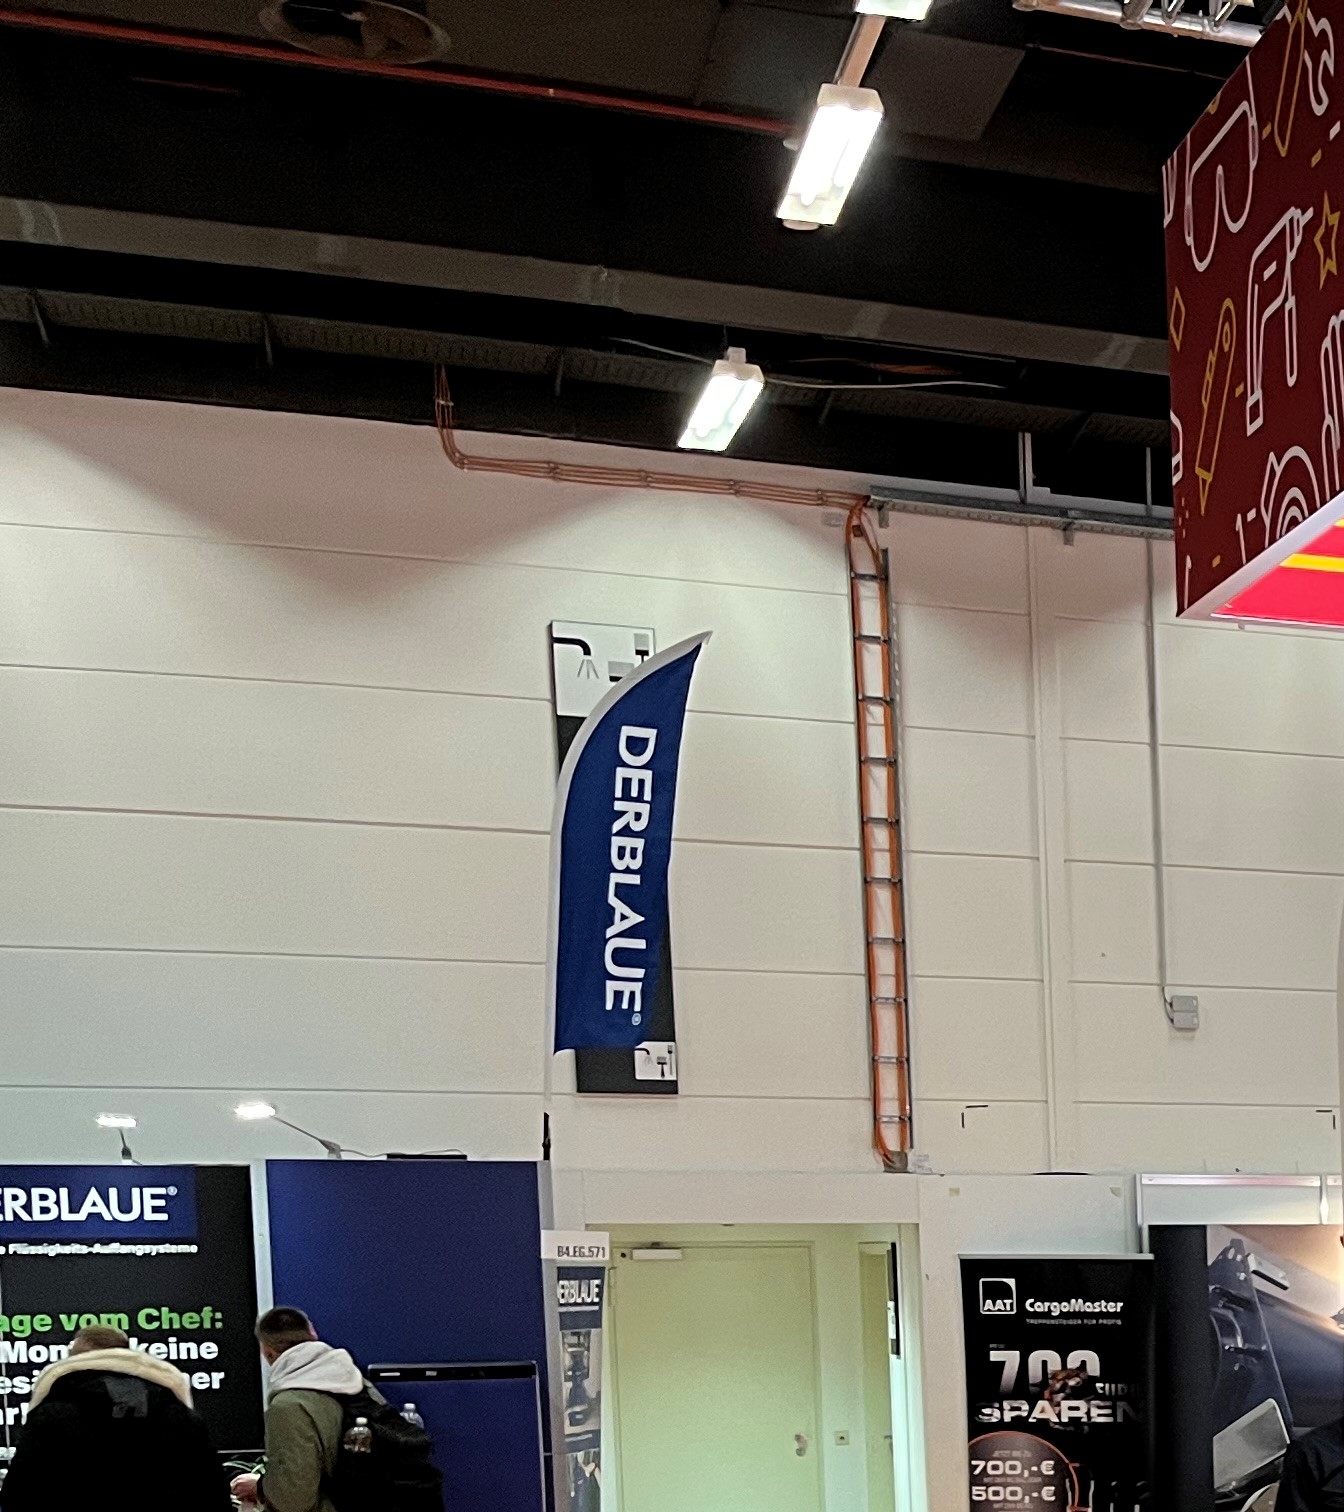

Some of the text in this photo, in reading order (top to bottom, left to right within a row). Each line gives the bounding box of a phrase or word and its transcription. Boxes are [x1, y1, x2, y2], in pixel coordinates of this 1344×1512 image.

[604, 725, 658, 1013] DERBLAUE
[0, 1186, 169, 1222] RBLAUE
[137, 1306, 224, 1331] Chef:
[983, 1298, 1124, 1316] AAT CargoMaster
[0, 1340, 74, 1364] Mon
[975, 1399, 1142, 1423] SPAREN
